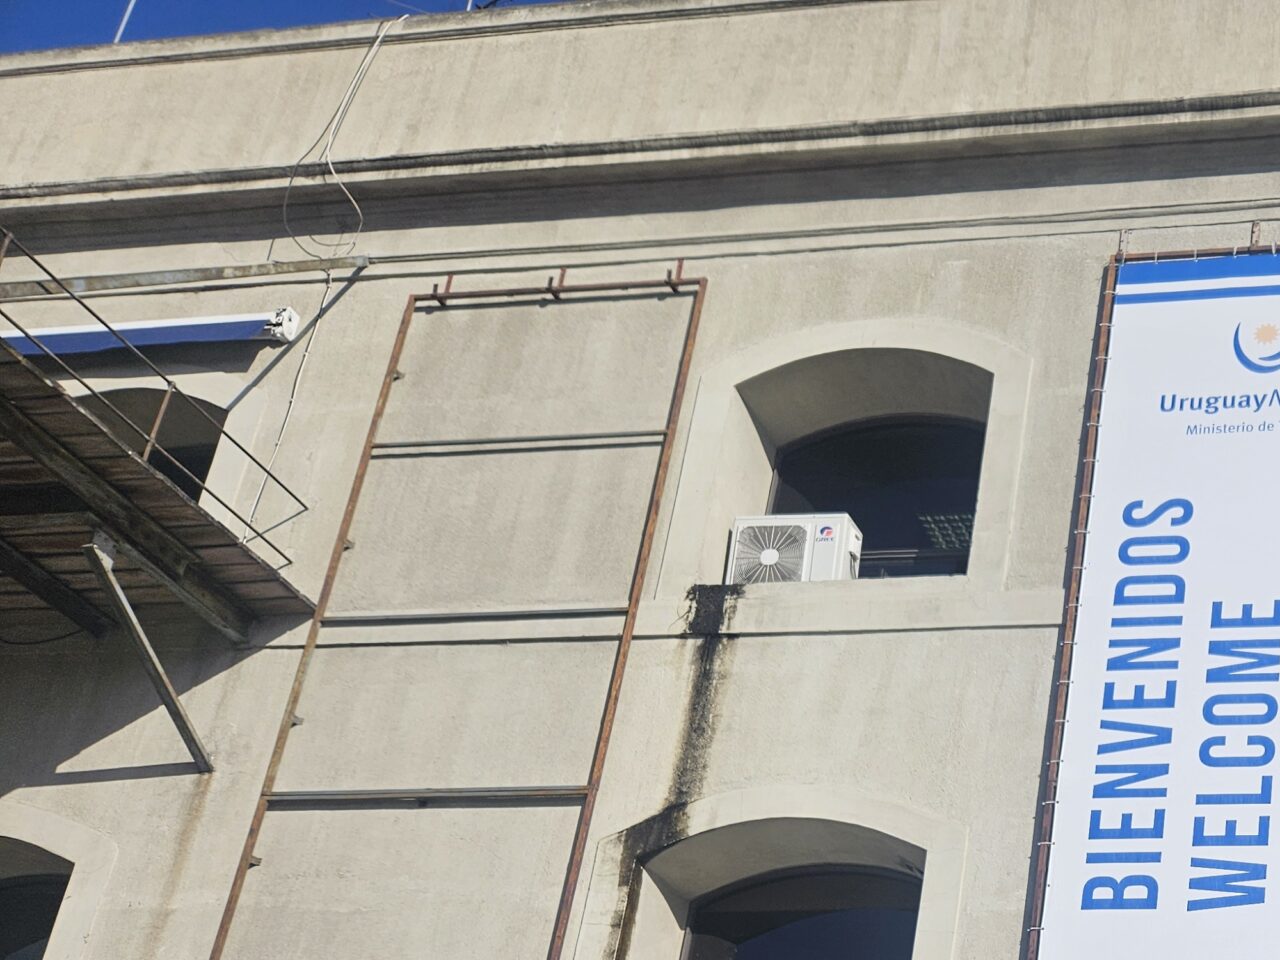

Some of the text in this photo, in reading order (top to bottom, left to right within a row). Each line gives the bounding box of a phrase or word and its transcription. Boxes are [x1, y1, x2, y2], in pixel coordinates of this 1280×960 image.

[1186, 422, 1254, 436] Ministerio
[1258, 420, 1274, 432] de
[1081, 498, 1194, 910] BIENVENIDOS
